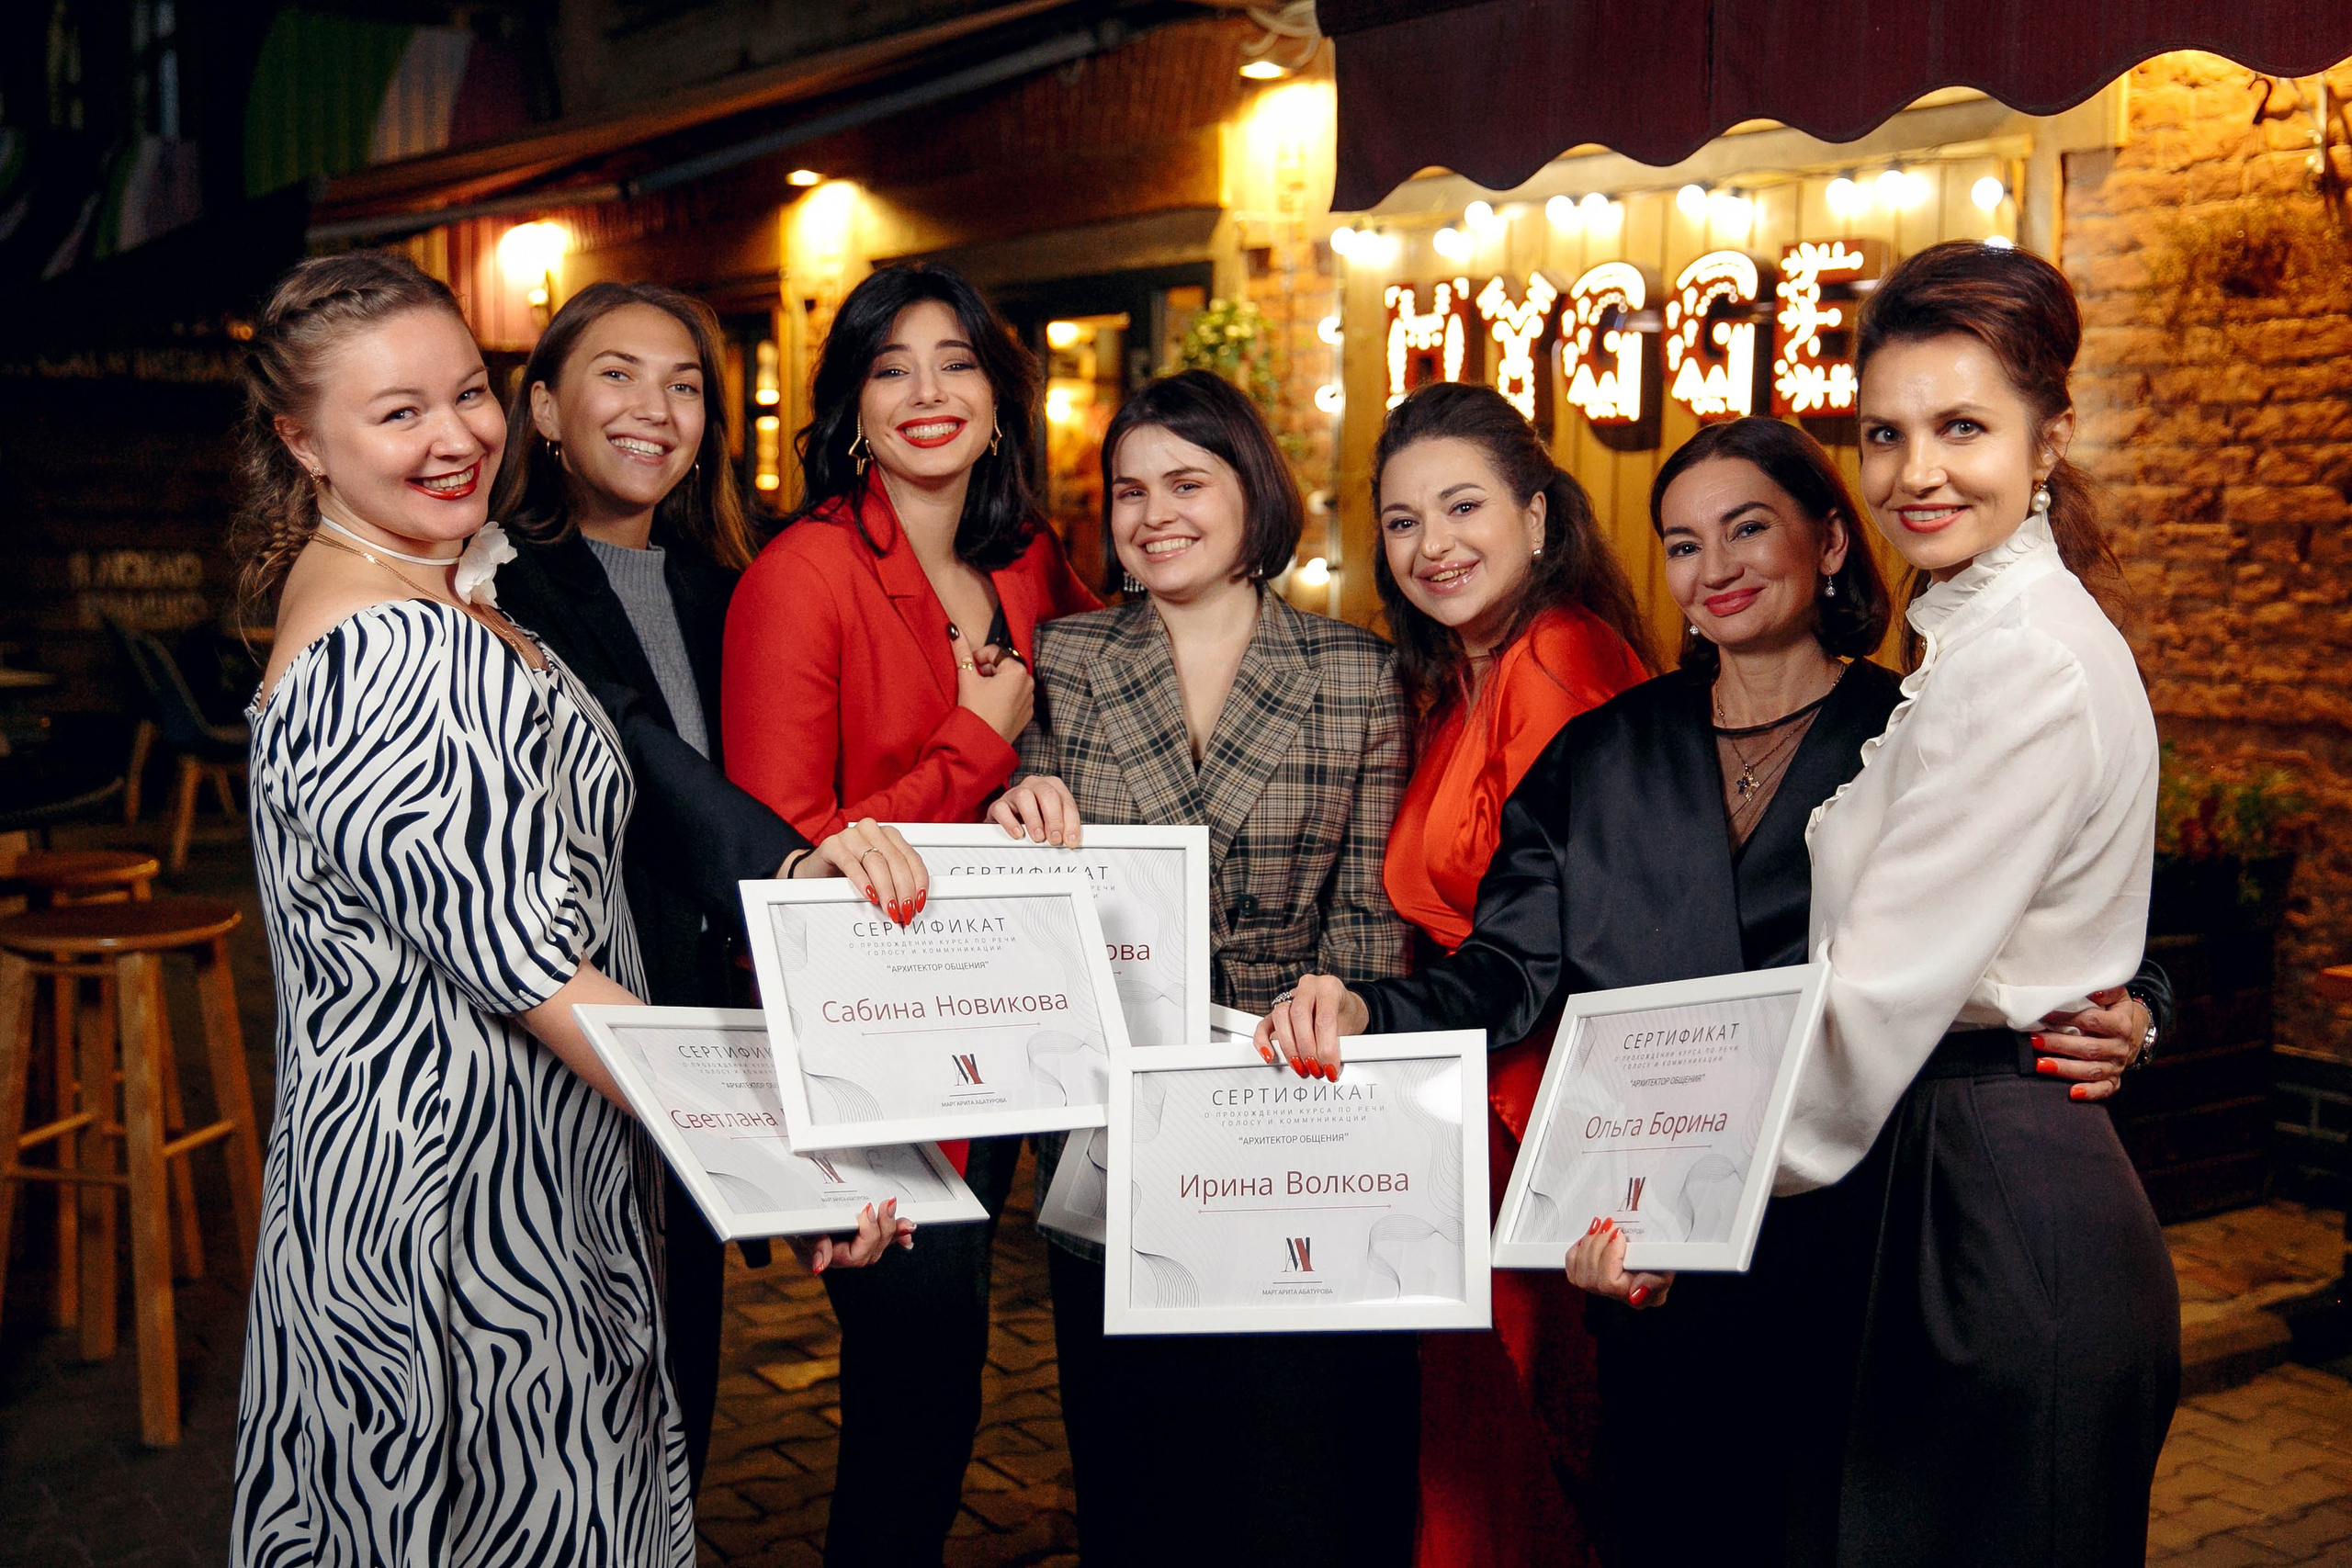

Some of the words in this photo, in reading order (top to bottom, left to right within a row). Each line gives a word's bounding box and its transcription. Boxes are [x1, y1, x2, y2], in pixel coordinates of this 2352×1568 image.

[1384, 235, 1867, 423] HYGGE
[853, 918, 1005, 937] СЕРТИФИКАТ
[861, 940, 934, 948] ПРОХОЖДЕНИИ
[868, 948, 906, 956] ГОЛОСУ
[923, 944, 1002, 954] КОММУНИКАЦИИ
[821, 998, 926, 1023] Сабина
[935, 993, 1069, 1018] Новикова
[1623, 1022, 1740, 1050] СЕРТИФИКАТ
[678, 1045, 774, 1058] СЕРТИФИК
[1212, 1084, 1377, 1105] СЕРТИФИКАТ
[671, 1110, 779, 1129] Светлана
[1216, 1108, 1293, 1118] ПРОХОЖДЕНИИ
[1299, 1107, 1332, 1115] КУРСА
[1222, 1119, 1261, 1127] ГОЛОСУ
[1279, 1115, 1367, 1124] КОММУНИКАЦИИ
[1585, 1115, 1643, 1139] Ольга
[1648, 1111, 1727, 1142] Борина
[1180, 1174, 1273, 1205] Ирина
[1286, 1170, 1409, 1195] Волкова
